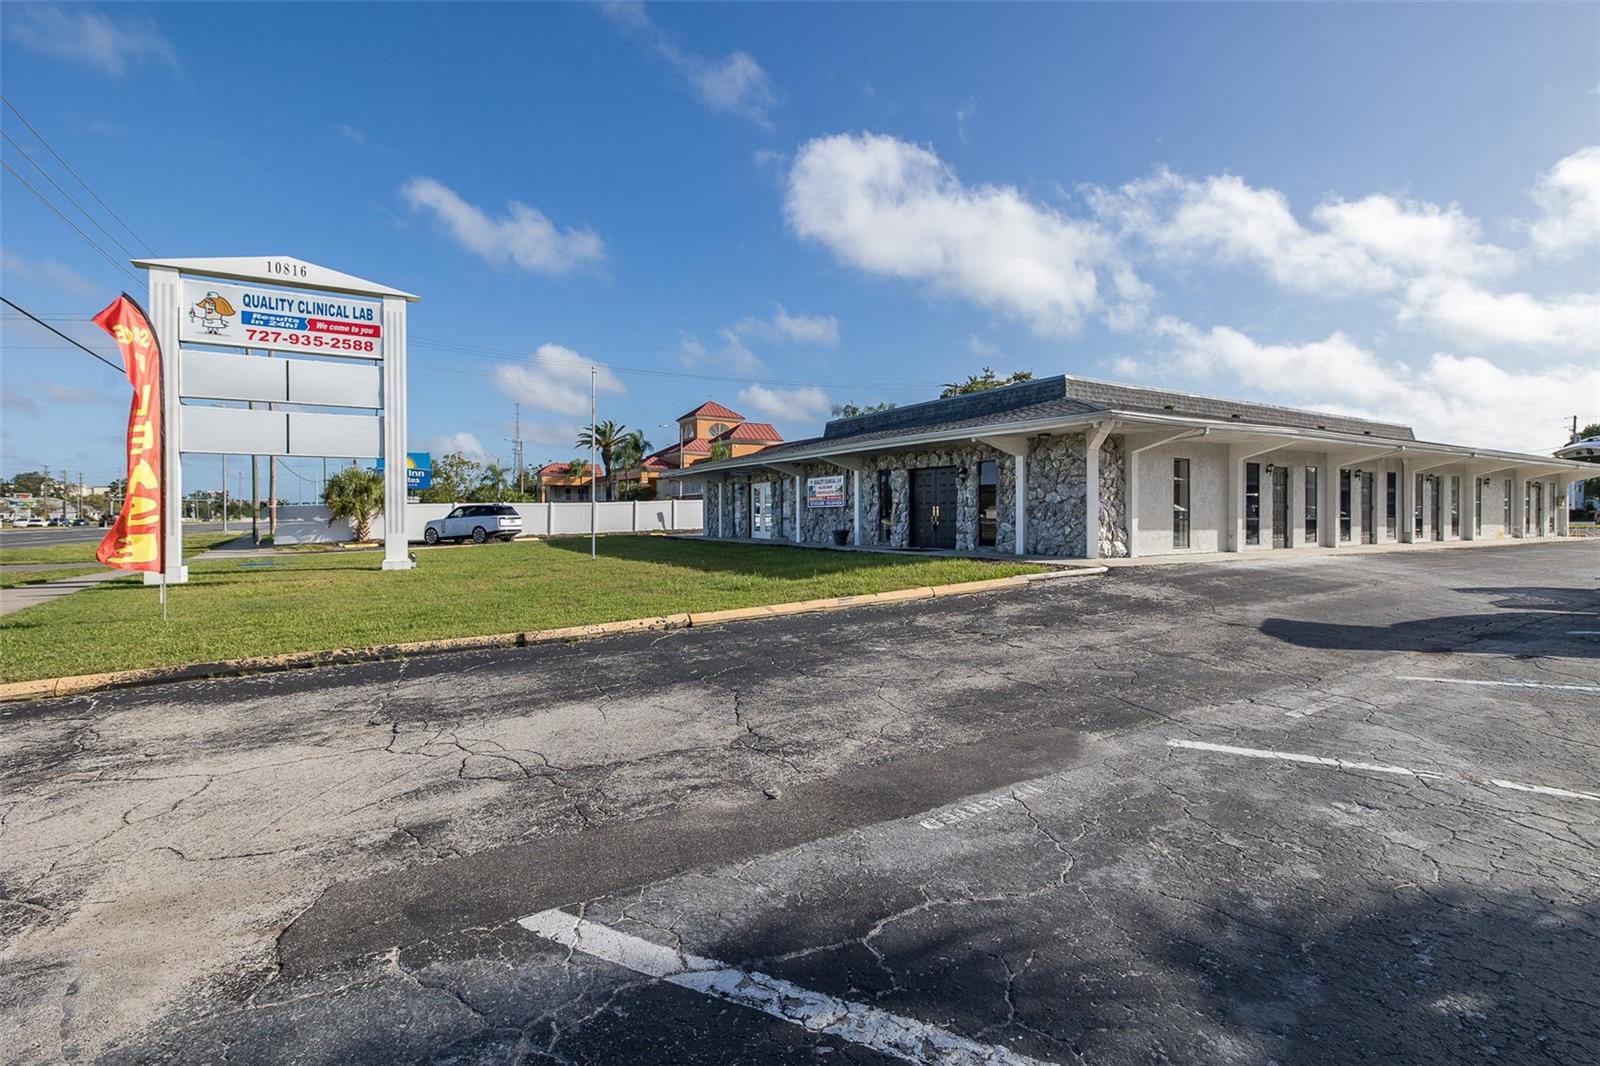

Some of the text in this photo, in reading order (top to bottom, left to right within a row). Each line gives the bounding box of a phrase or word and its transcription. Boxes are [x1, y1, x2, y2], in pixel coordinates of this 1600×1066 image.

[267, 261, 307, 278] 10816
[242, 293, 374, 321] QUALITY CLINICAL LAB
[252, 313, 300, 324] Results
[316, 321, 328, 330] We
[328, 324, 350, 332] come
[359, 327, 374, 335] you
[246, 328, 374, 352] 727-935-2588
